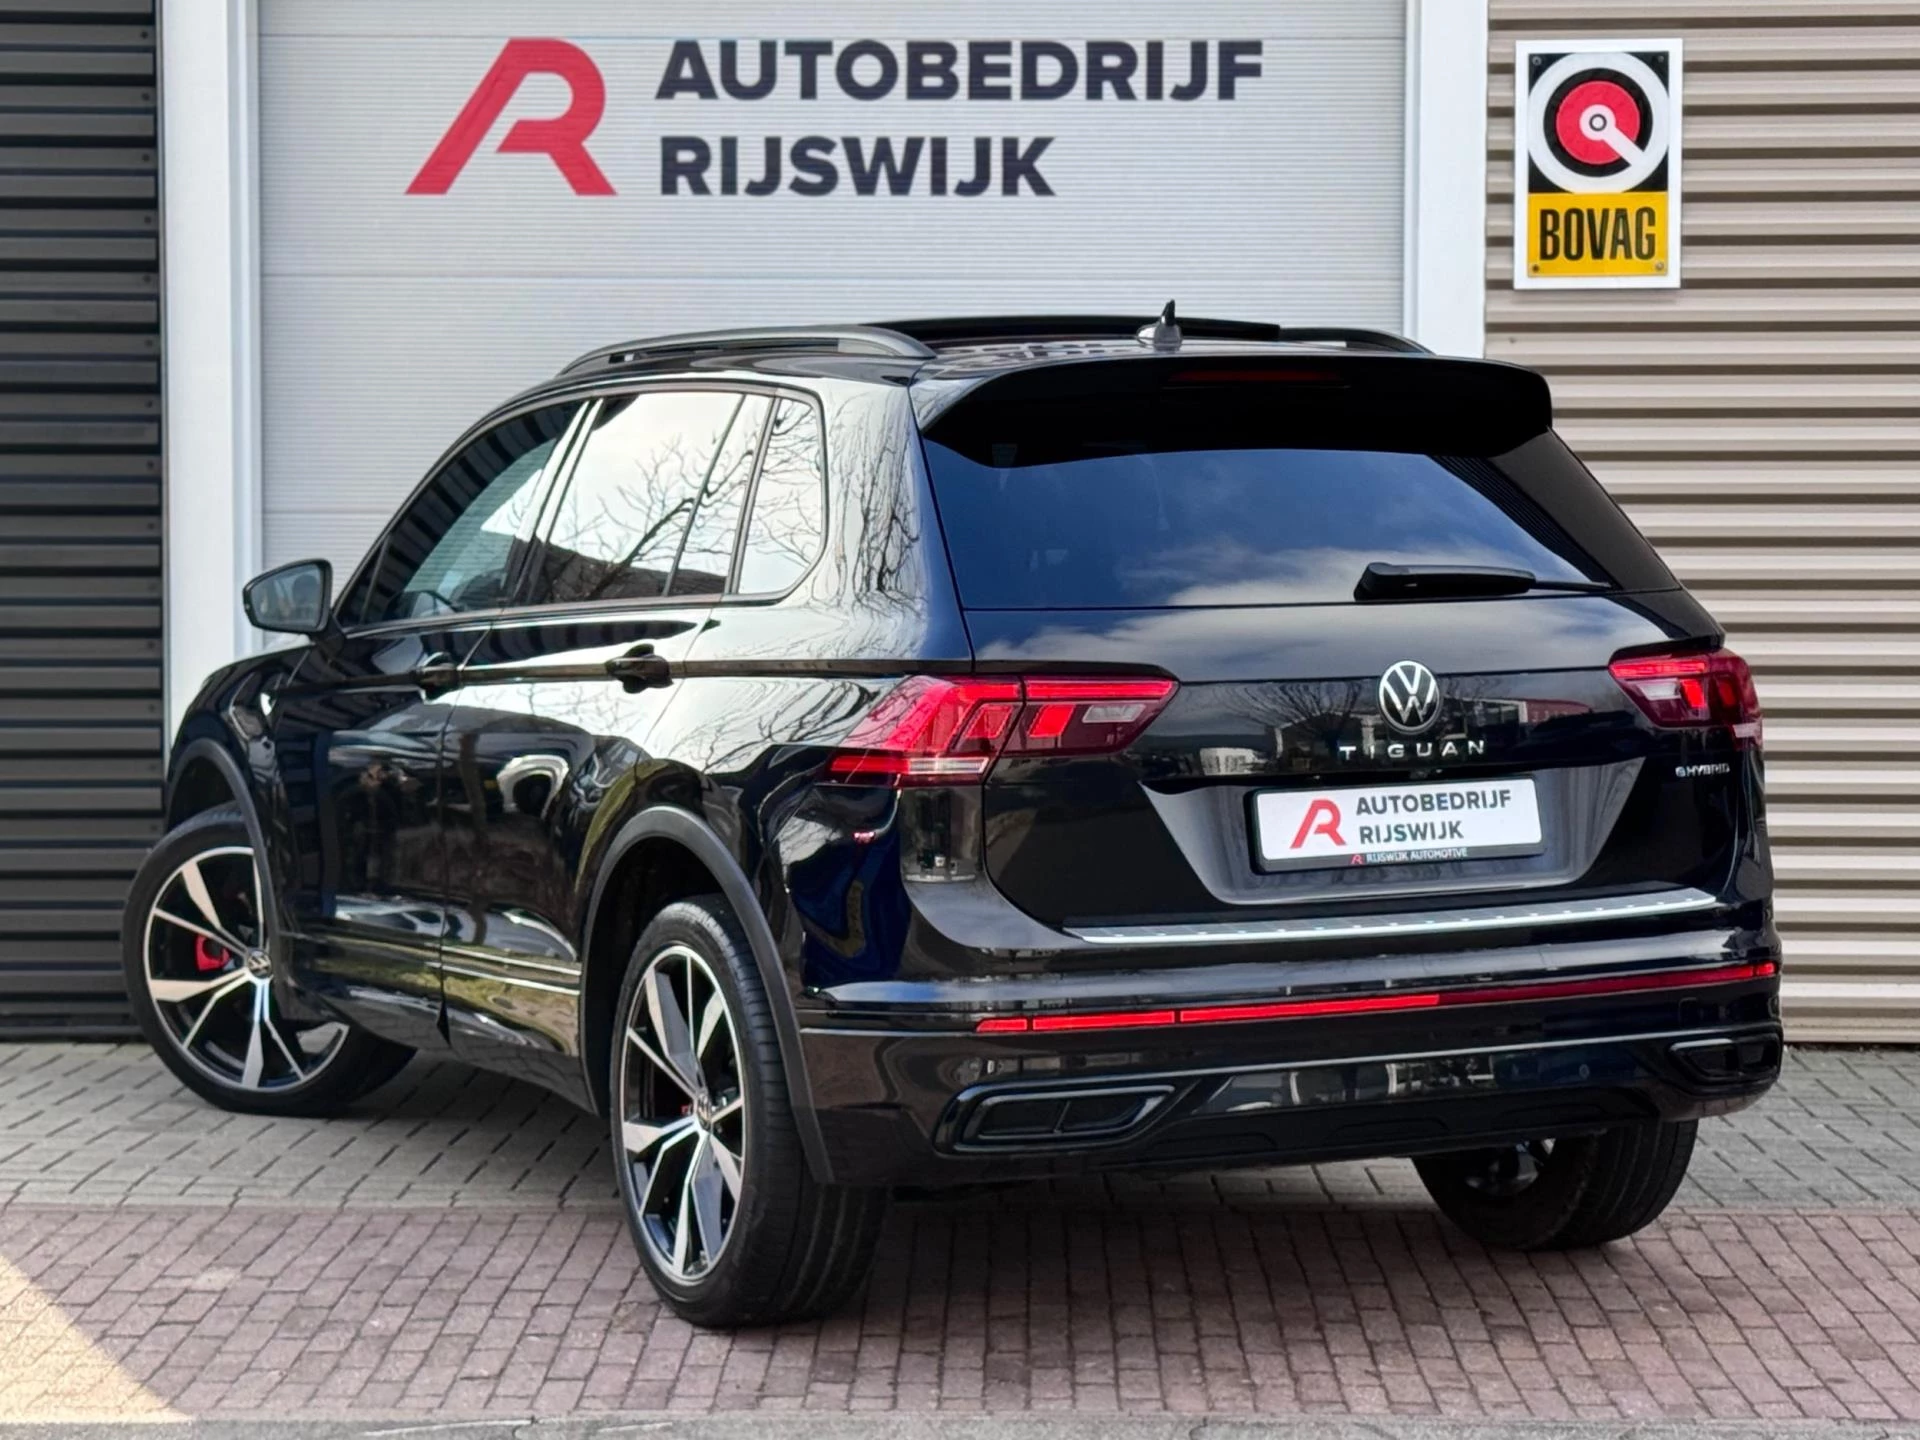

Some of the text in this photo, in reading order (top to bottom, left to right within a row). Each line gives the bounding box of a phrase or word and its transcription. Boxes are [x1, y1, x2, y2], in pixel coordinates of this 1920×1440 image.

[656, 39, 1263, 101] AUTOBEDRIJF
[660, 135, 1055, 197] RIJSWIJK
[1539, 206, 1656, 261] BOVAG
[1338, 739, 1485, 761] TIGUAN
[1356, 789, 1512, 816] AUTOBEDRIJF
[1359, 820, 1464, 845] RIJSWIJK
[1366, 847, 1468, 864] RIJSWIJK AUTOMOTIVE
